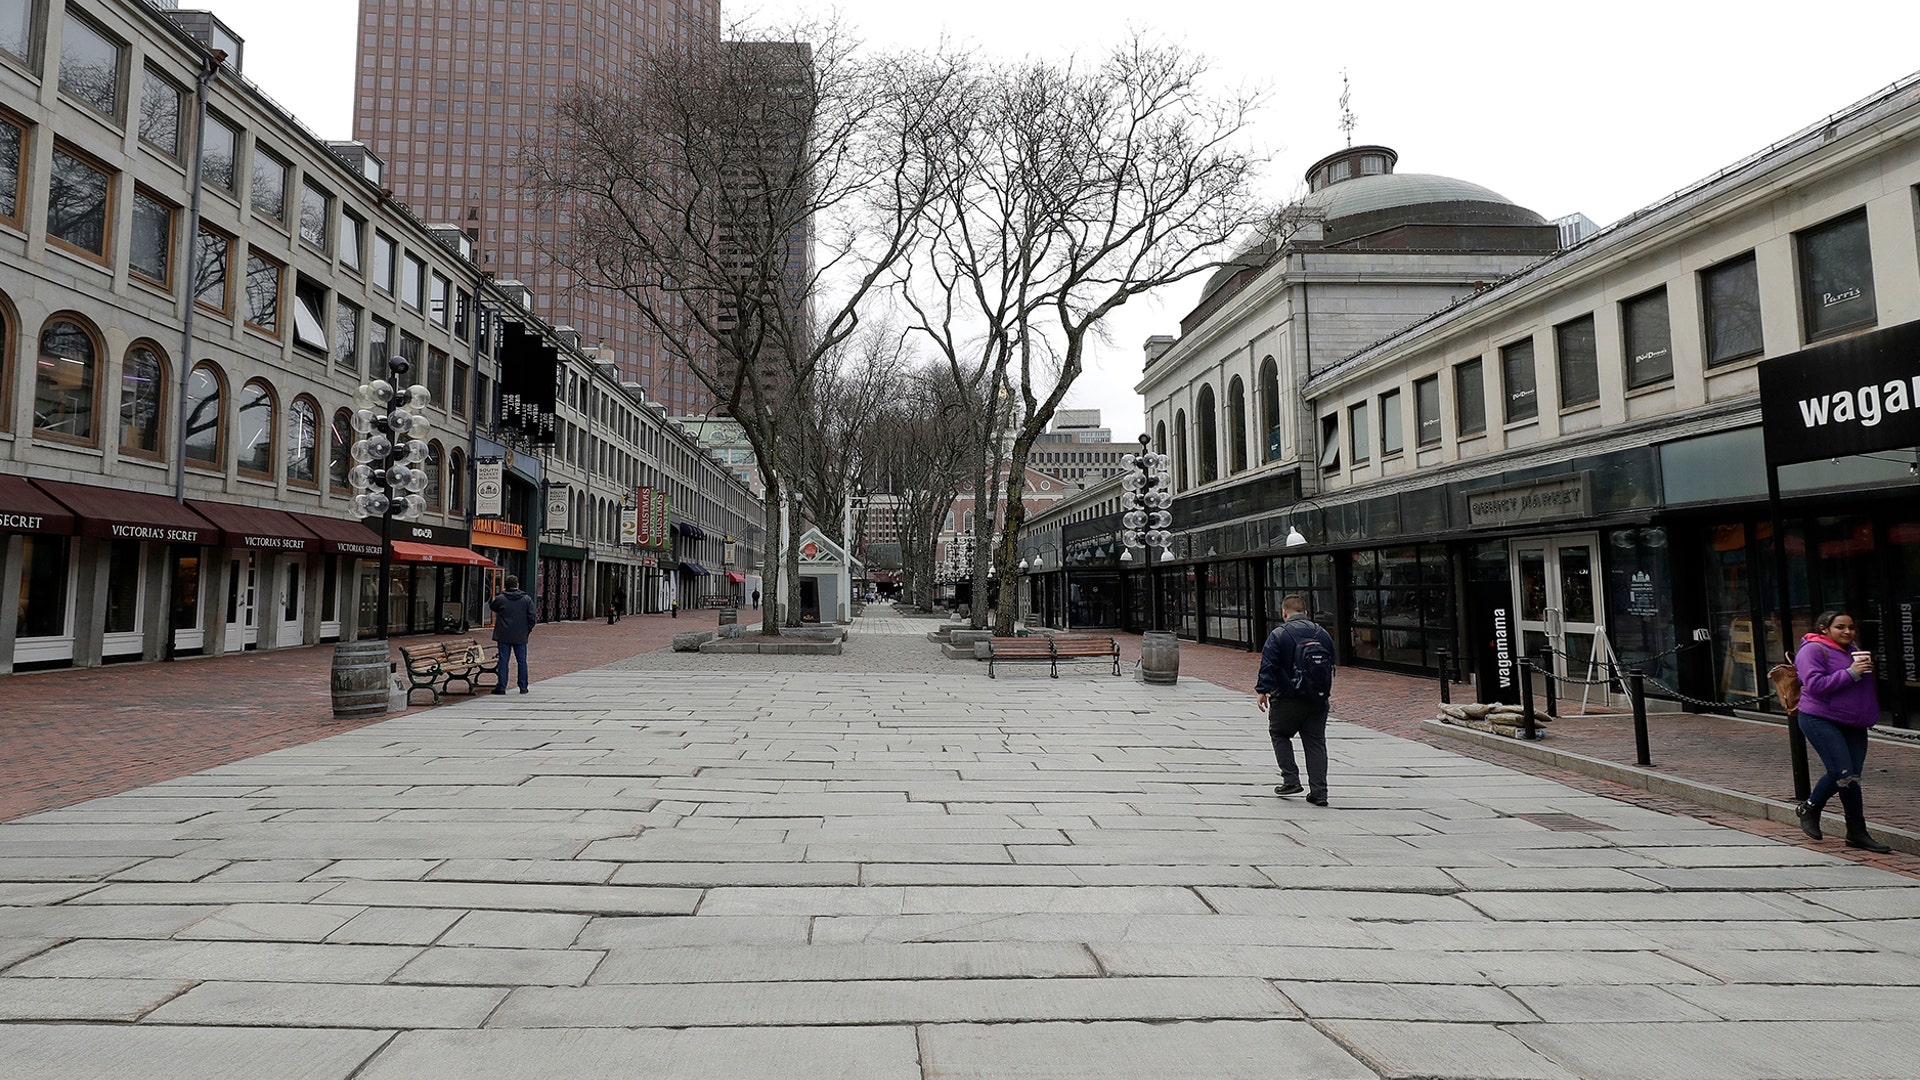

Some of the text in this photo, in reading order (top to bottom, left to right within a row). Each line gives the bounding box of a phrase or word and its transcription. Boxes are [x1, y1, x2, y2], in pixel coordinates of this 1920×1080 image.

[1823, 286, 1861, 306] Parris
[1473, 488, 1581, 515] QUINCY MARKET
[638, 488, 651, 544] CHRISTMAS
[656, 494, 664, 547] CHRISTMAS
[112, 524, 198, 542] VICTORIA'S SECRET
[473, 519, 523, 537] URBAN OUTFITTERS
[622, 522, 636, 536] 2
[244, 535, 305, 549] VICTORIA'S SECRET
[337, 542, 364, 553] VICTORIA'S
[1494, 609, 1512, 689] wagamama
